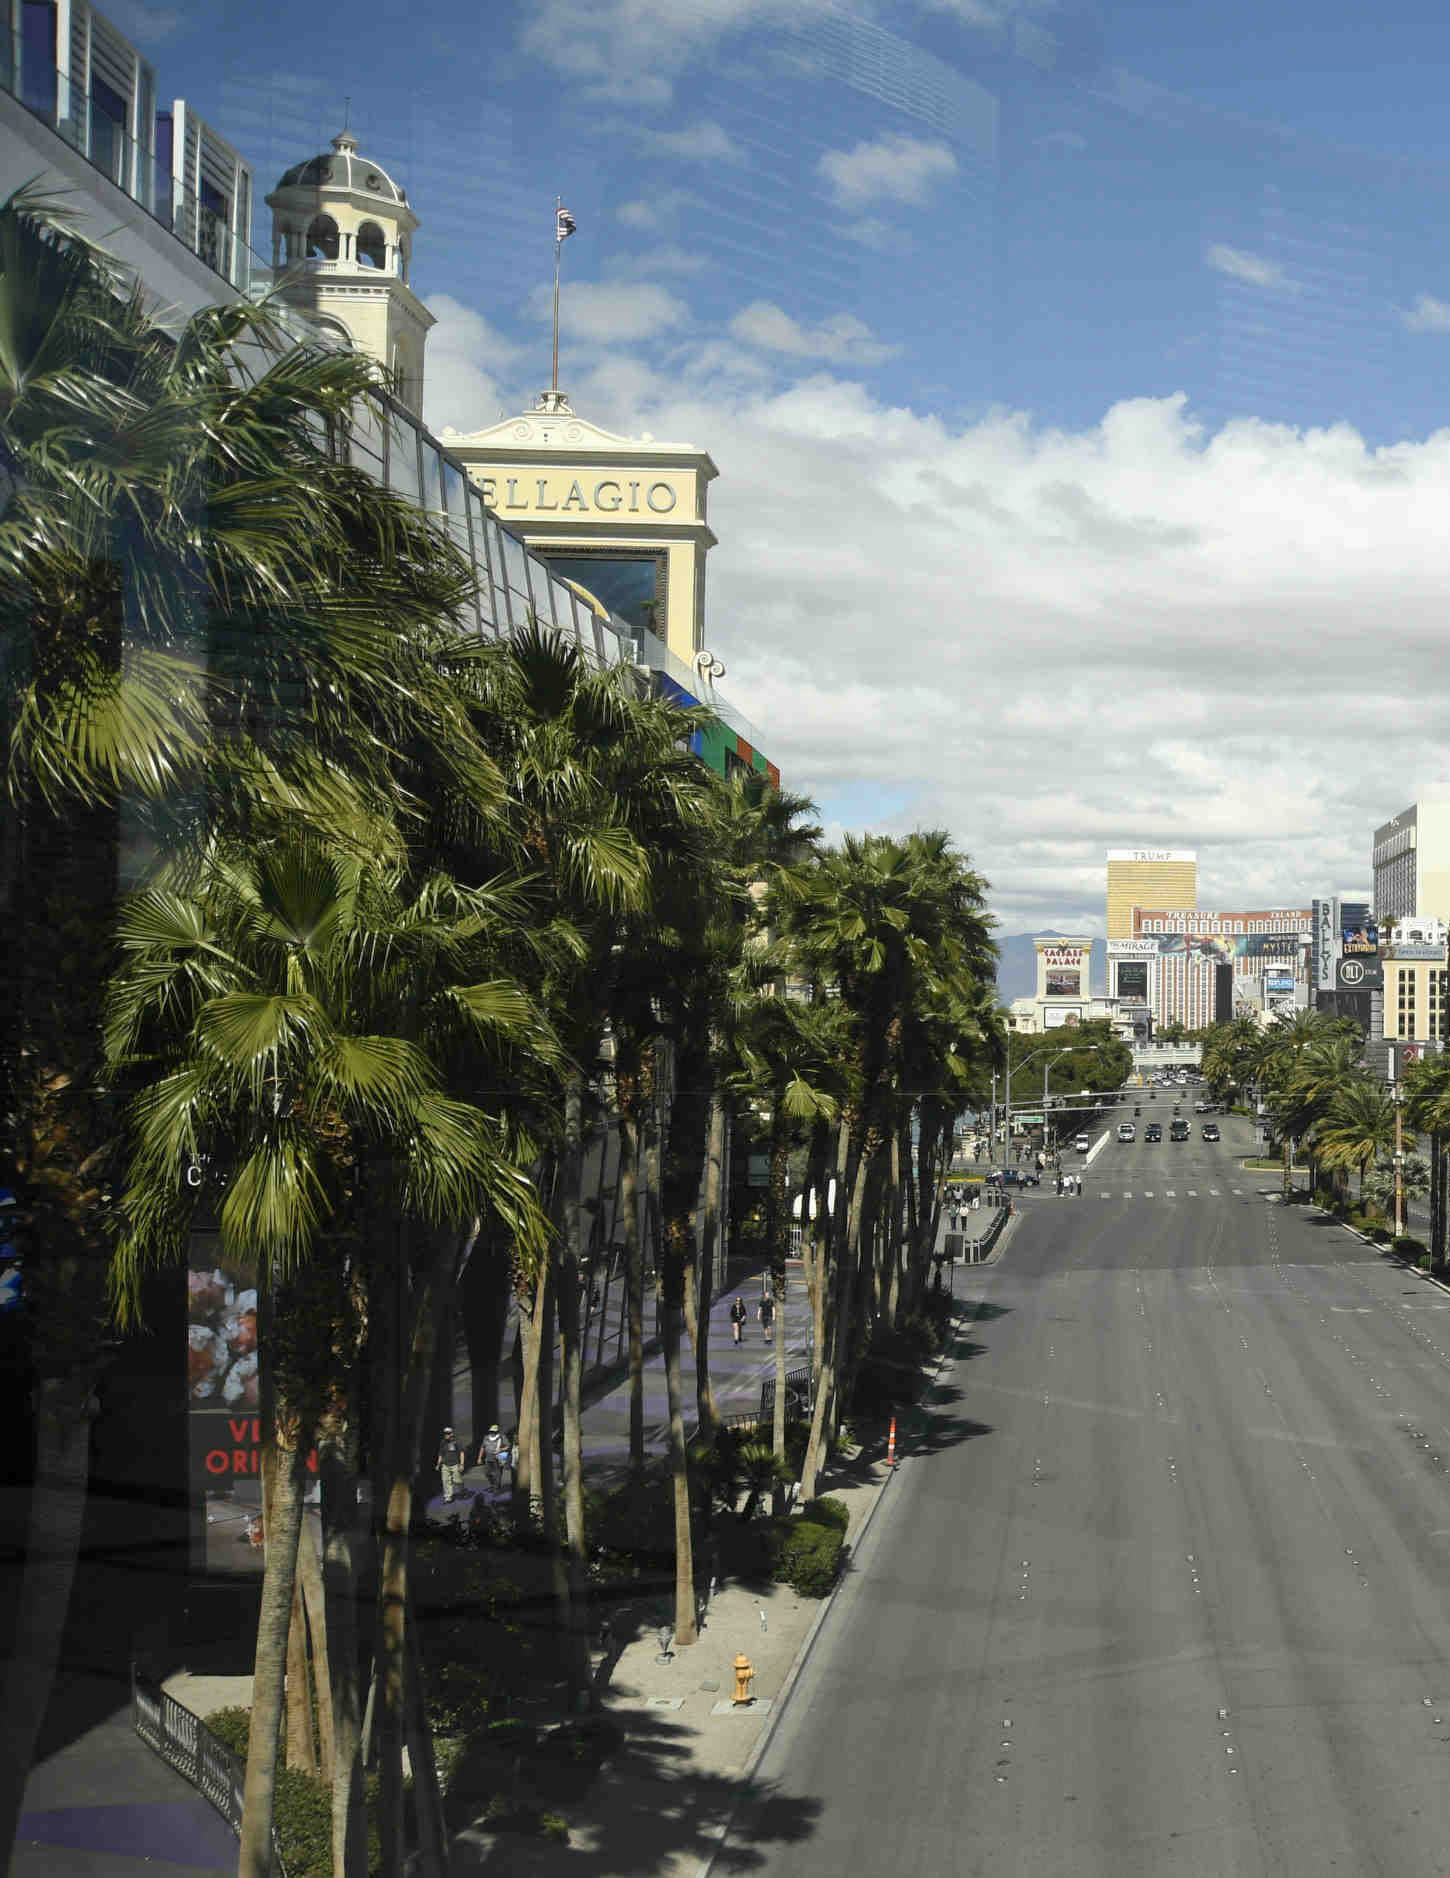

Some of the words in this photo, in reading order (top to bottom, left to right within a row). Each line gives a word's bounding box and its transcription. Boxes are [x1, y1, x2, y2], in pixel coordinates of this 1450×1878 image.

[476, 478, 677, 514] ELLAGIO
[1133, 851, 1172, 860] TRUMP
[1120, 942, 1156, 951] MIRAGE
[1044, 949, 1083, 957] CAESARS
[1047, 958, 1080, 966] PALACE
[206, 1449, 319, 1474] ORIN
